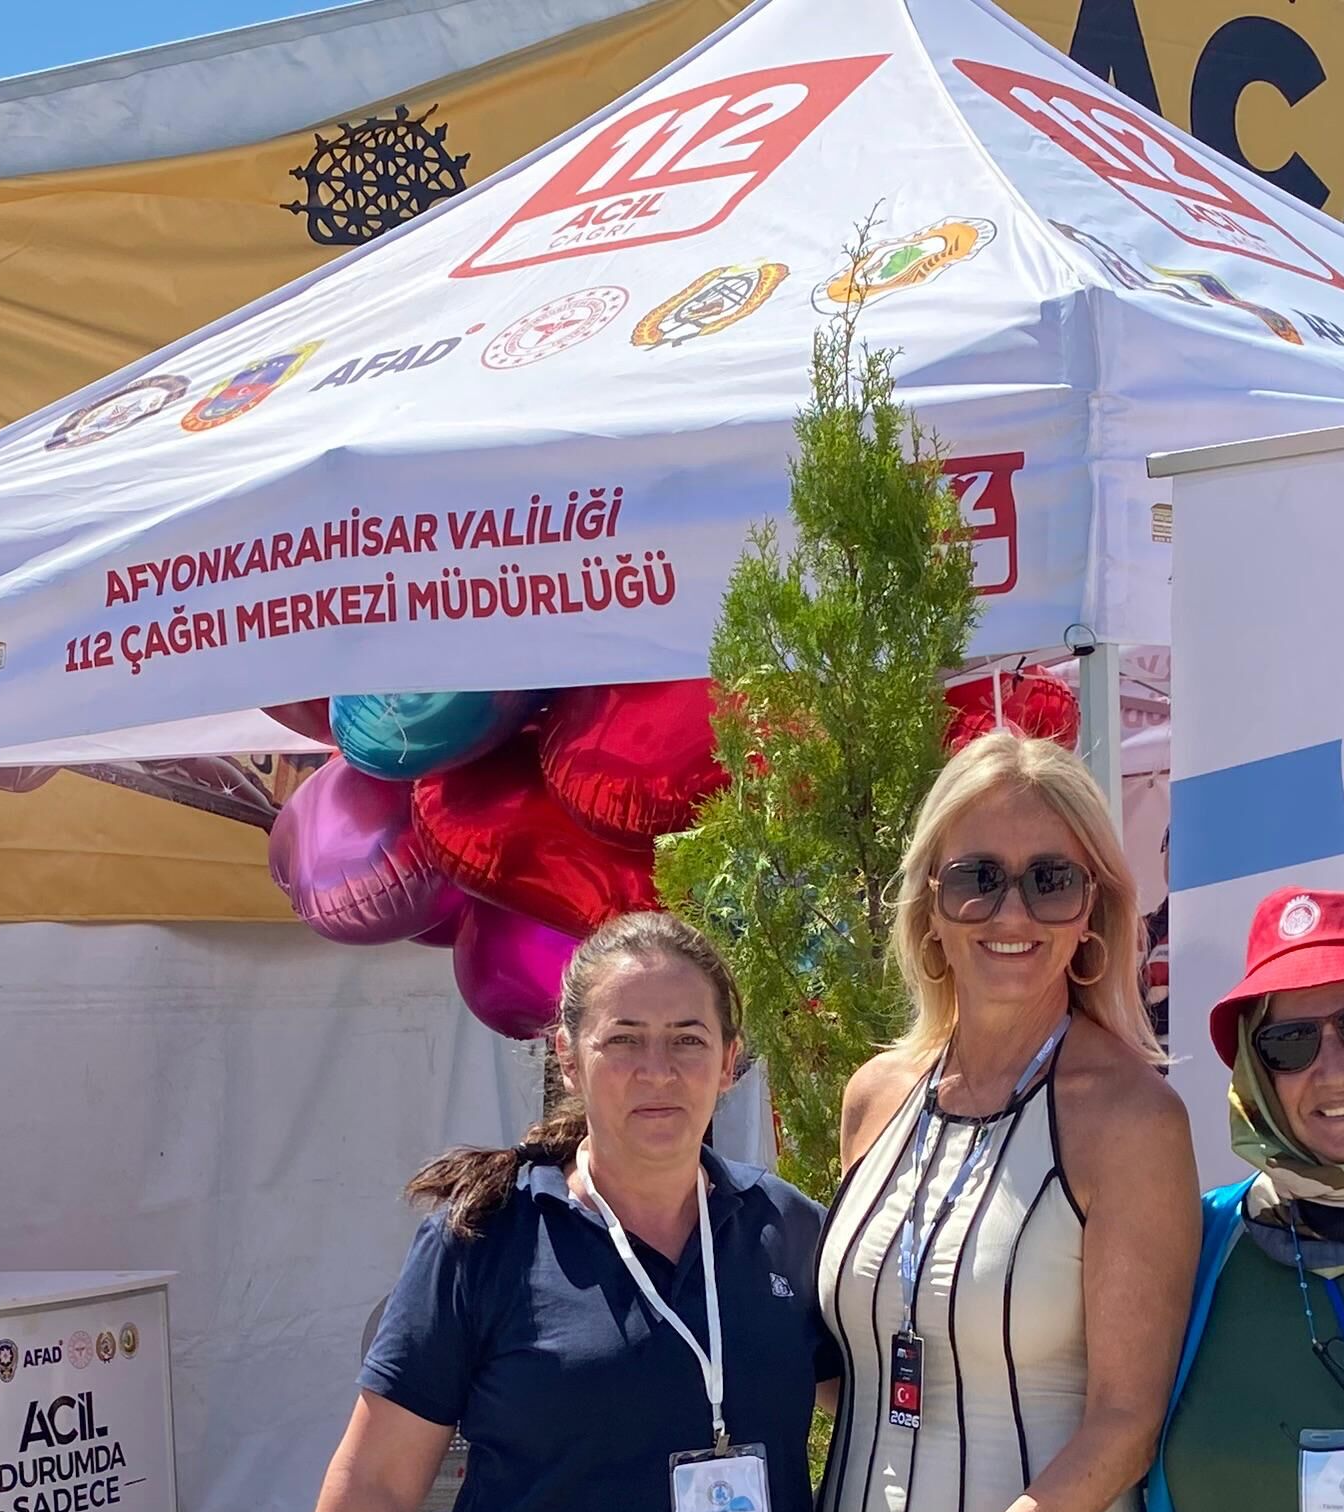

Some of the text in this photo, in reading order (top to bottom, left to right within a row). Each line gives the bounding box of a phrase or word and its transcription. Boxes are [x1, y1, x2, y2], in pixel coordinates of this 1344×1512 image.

[576, 83, 809, 196] 112
[1009, 86, 1233, 202] 112
[308, 337, 462, 392] AFAD
[105, 486, 624, 608] AFYONKARAHİSAR VALİLİĞİ
[65, 550, 676, 675] 112 ÇAĞRI MERKEZİ MÜDÜRLÜĞÜ
[23, 1346, 62, 1368] AFAD
[18, 1391, 109, 1453] ACİL
[890, 1411, 921, 1428] 2026
